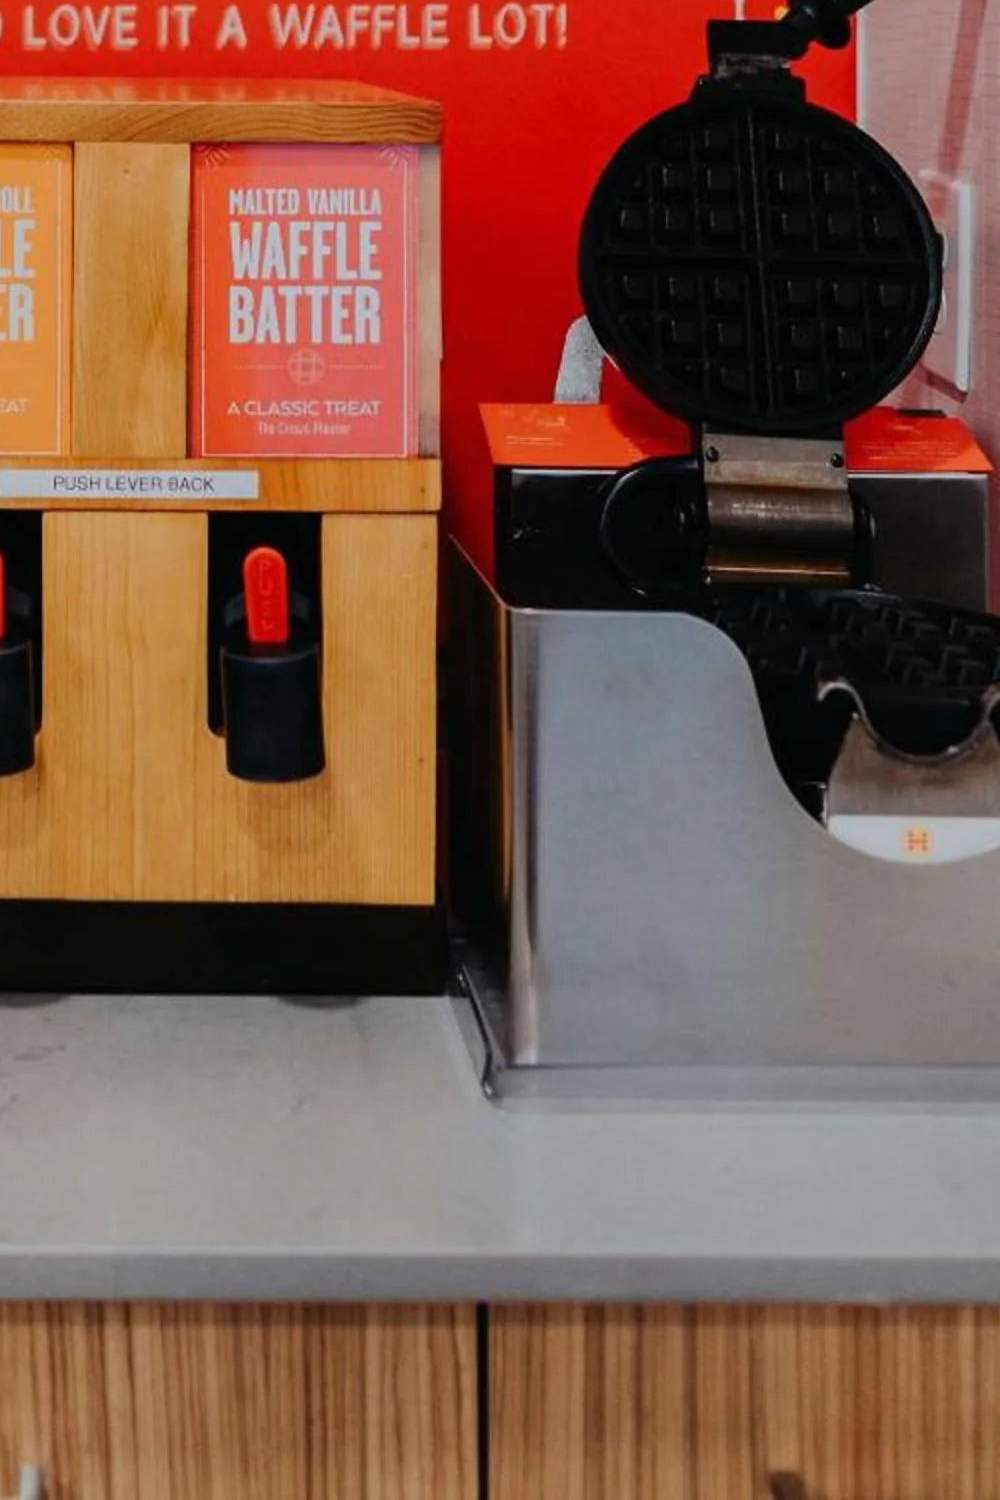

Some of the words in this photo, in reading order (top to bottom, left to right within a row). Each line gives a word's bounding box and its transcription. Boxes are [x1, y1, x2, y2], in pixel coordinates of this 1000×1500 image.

[22, 2, 138, 50] LOVE
[157, 3, 197, 49] IT
[215, 3, 251, 49] A
[269, 2, 449, 51] WAFFLE
[467, 2, 569, 51] LOT!
[229, 188, 299, 215] MALTED
[307, 188, 382, 215] VANILLA
[229, 221, 382, 280] WAFFLE
[229, 285, 381, 344] BATTER
[227, 401, 240, 416] A
[244, 400, 319, 416] CLASSIC
[325, 400, 382, 416] TREAT
[53, 475, 100, 491] PUSH
[106, 476, 163, 491] LEVER
[169, 477, 215, 492] BACK
